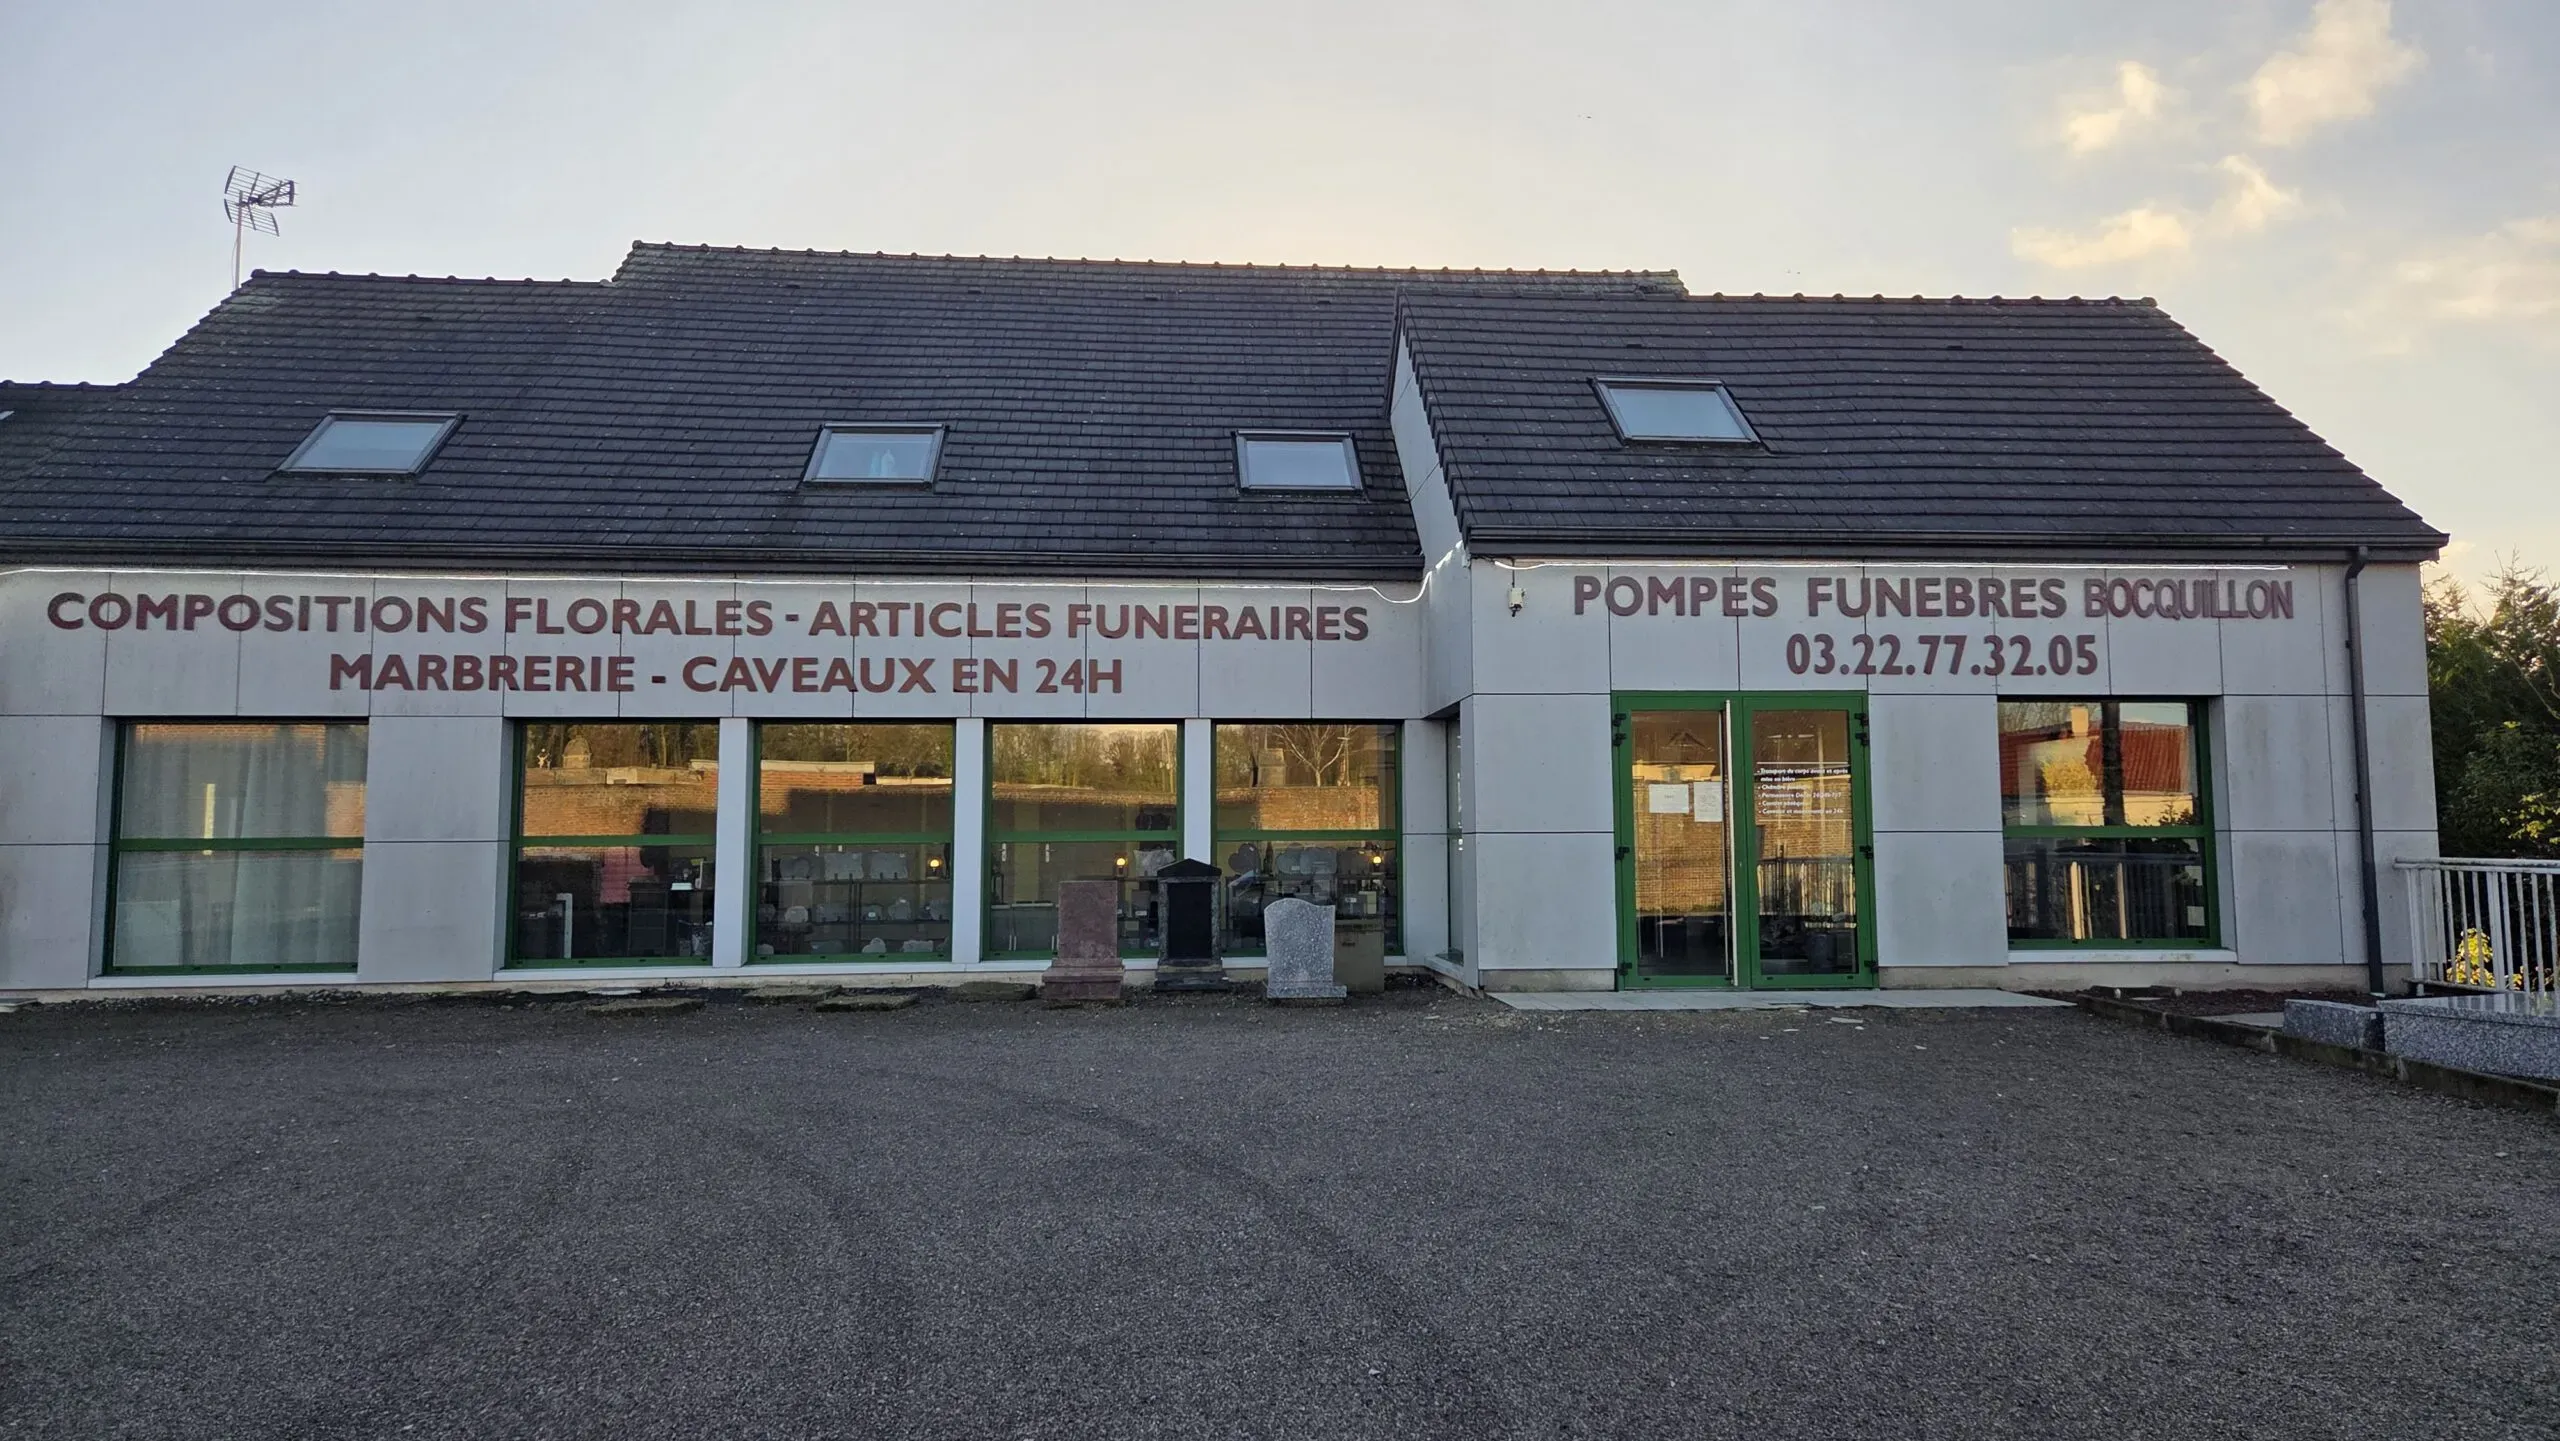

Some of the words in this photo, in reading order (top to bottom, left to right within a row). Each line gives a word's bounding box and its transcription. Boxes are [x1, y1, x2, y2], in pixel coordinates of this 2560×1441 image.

[47, 592, 488, 633] COMPOSITIONS
[506, 598, 773, 635] FLORALES
[808, 600, 1051, 639] ARTICLES
[1068, 603, 1369, 641] FUNERAIRES
[1573, 576, 1779, 617] POMPES
[1807, 577, 2067, 618] FUNEBRES
[2083, 577, 2294, 620] BOCQUILLON
[330, 653, 634, 692] MARBRERIE
[683, 656, 935, 693] CAVEAUX
[953, 658, 1018, 693] EN
[1035, 658, 1122, 693] 24H
[1787, 634, 2098, 676] 03.22.77.32.05
